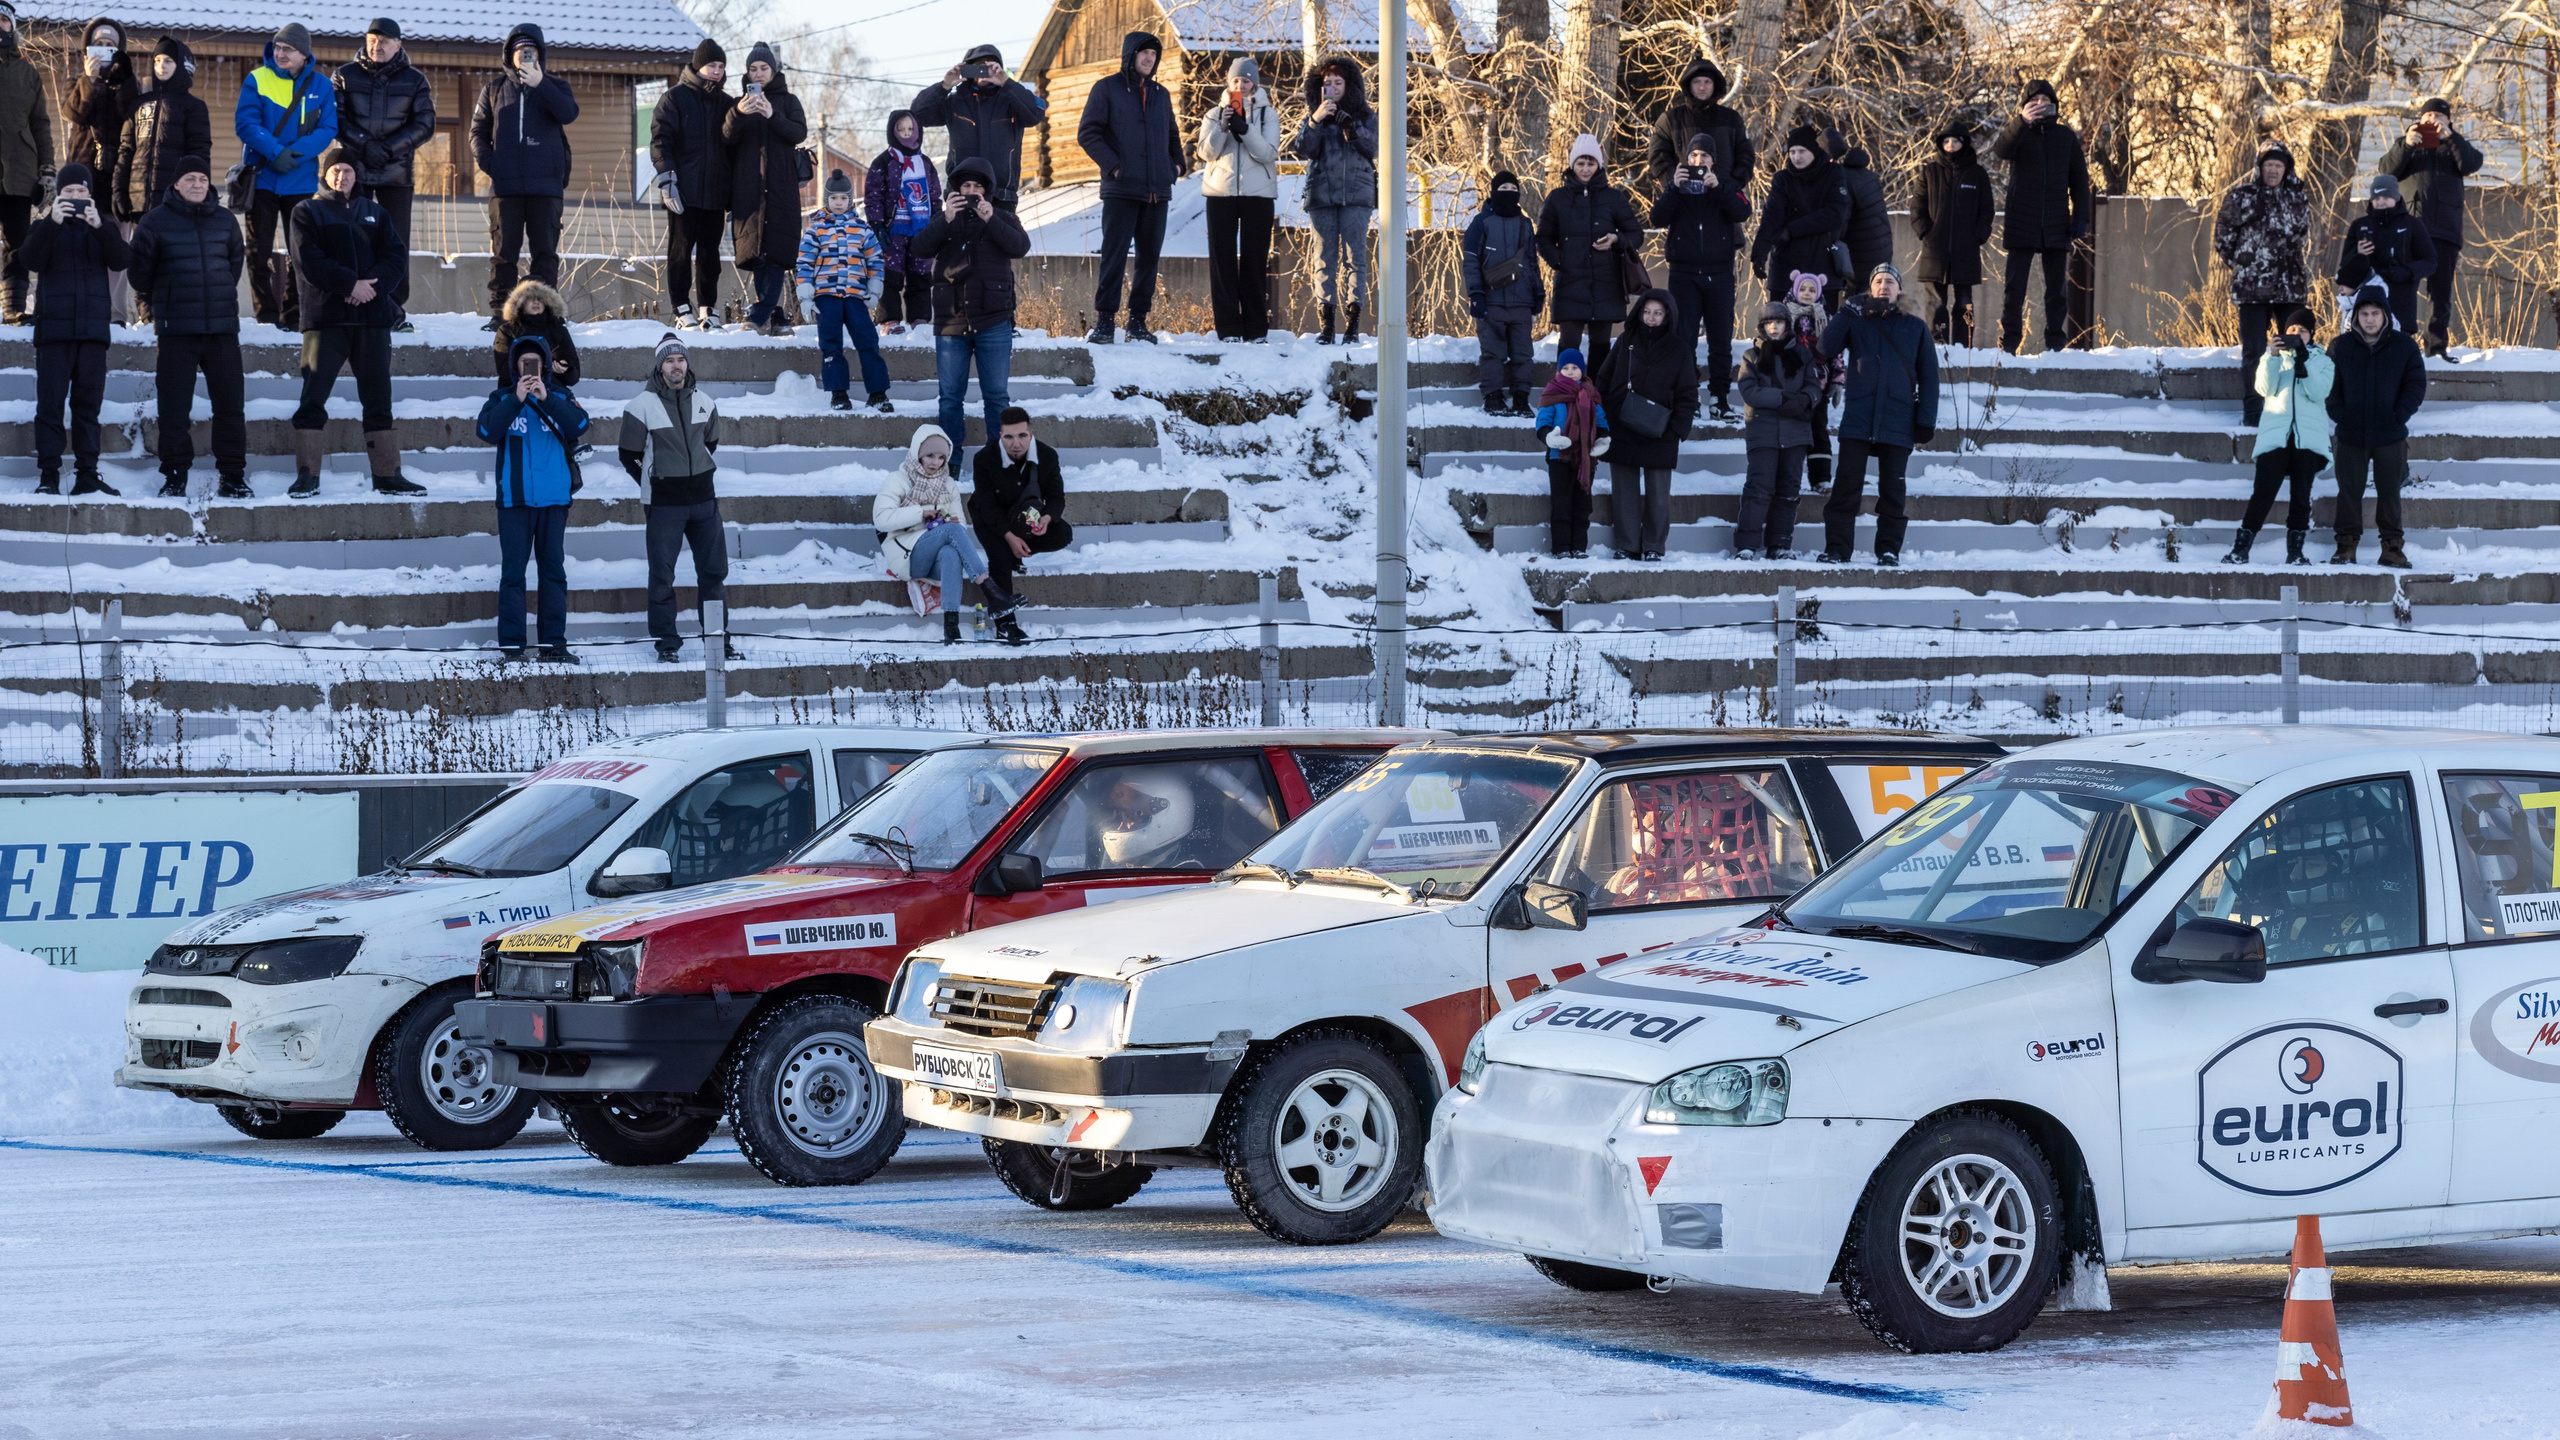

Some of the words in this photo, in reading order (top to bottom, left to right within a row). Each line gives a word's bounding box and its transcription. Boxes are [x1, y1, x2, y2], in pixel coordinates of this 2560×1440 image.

[508, 416, 528, 434] US
[1398, 829, 1473, 849] ШЕВЧЕНКО
[1474, 828, 1494, 844] Ю.
[1887, 853, 1981, 874] алашв
[1985, 844, 2030, 866] В.В.
[478, 910, 495, 925] А.
[2504, 900, 2560, 924] ПЛОТНИ
[505, 933, 576, 950] НОВОСИБИРСК
[785, 923, 866, 945] ШЕВЧЕНКО
[868, 921, 888, 939] Ю.
[1665, 947, 1779, 966] Silver
[1764, 957, 1869, 986] Rain
[1548, 1005, 1706, 1044] eurol
[2047, 1032, 2105, 1056] eurol
[914, 1053, 974, 1080] РУБЦОВСК
[976, 1056, 992, 1079] 22
[2213, 1081, 2388, 1147] eurol
[2237, 1143, 2366, 1164] LUBRICANTS
